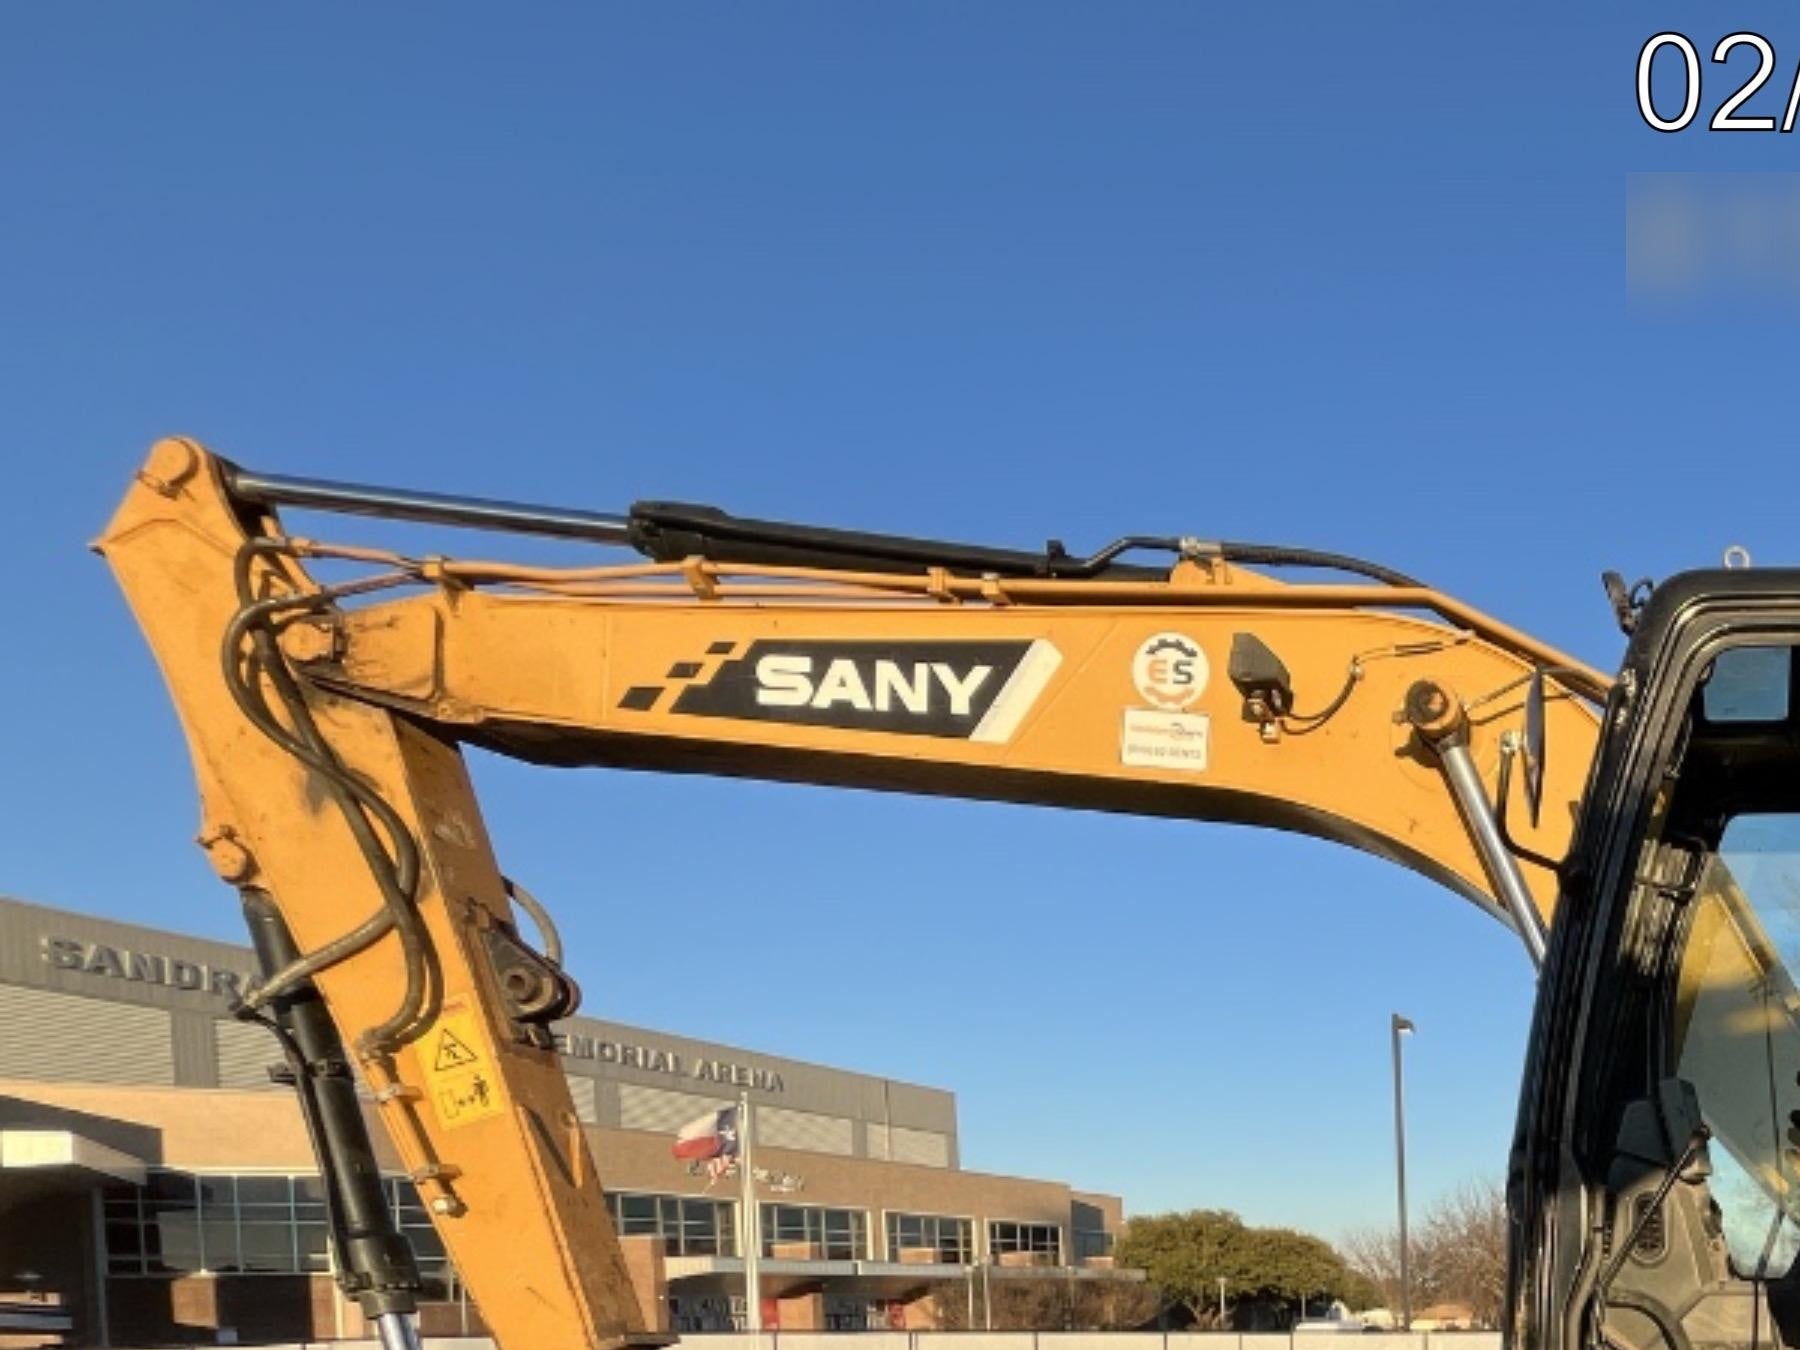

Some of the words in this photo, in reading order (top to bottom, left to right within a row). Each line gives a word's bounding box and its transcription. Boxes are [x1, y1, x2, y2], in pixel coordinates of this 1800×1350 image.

[755, 653, 994, 716] SANY
[1148, 659, 1195, 685] ES
[550, 1032, 683, 1077] EMORIAL
[694, 1057, 786, 1093] ARENA
